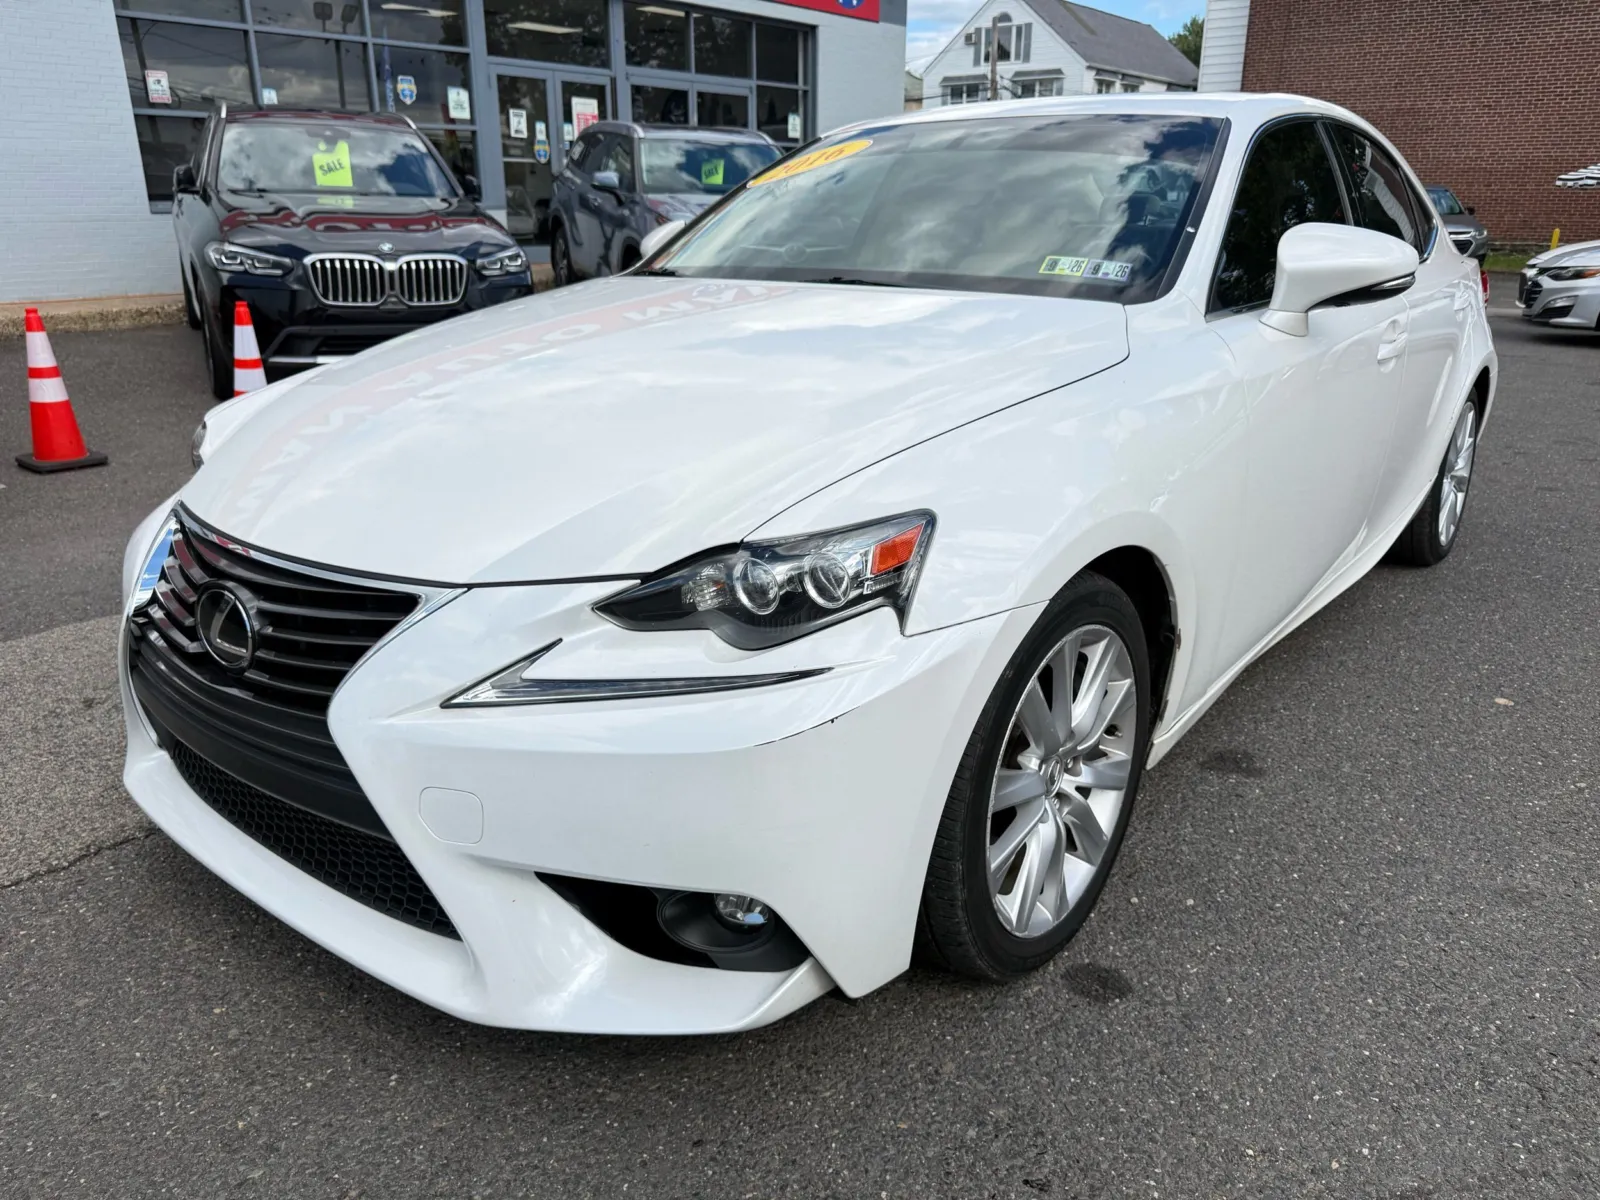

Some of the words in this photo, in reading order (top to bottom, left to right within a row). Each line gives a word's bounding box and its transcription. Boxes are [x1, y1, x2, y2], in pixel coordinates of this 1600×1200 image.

[318, 157, 346, 177] SALE
[703, 163, 720, 180] SALE
[1070, 259, 1085, 273] 26
[1091, 263, 1102, 276] 9
[1114, 264, 1129, 278] 26
